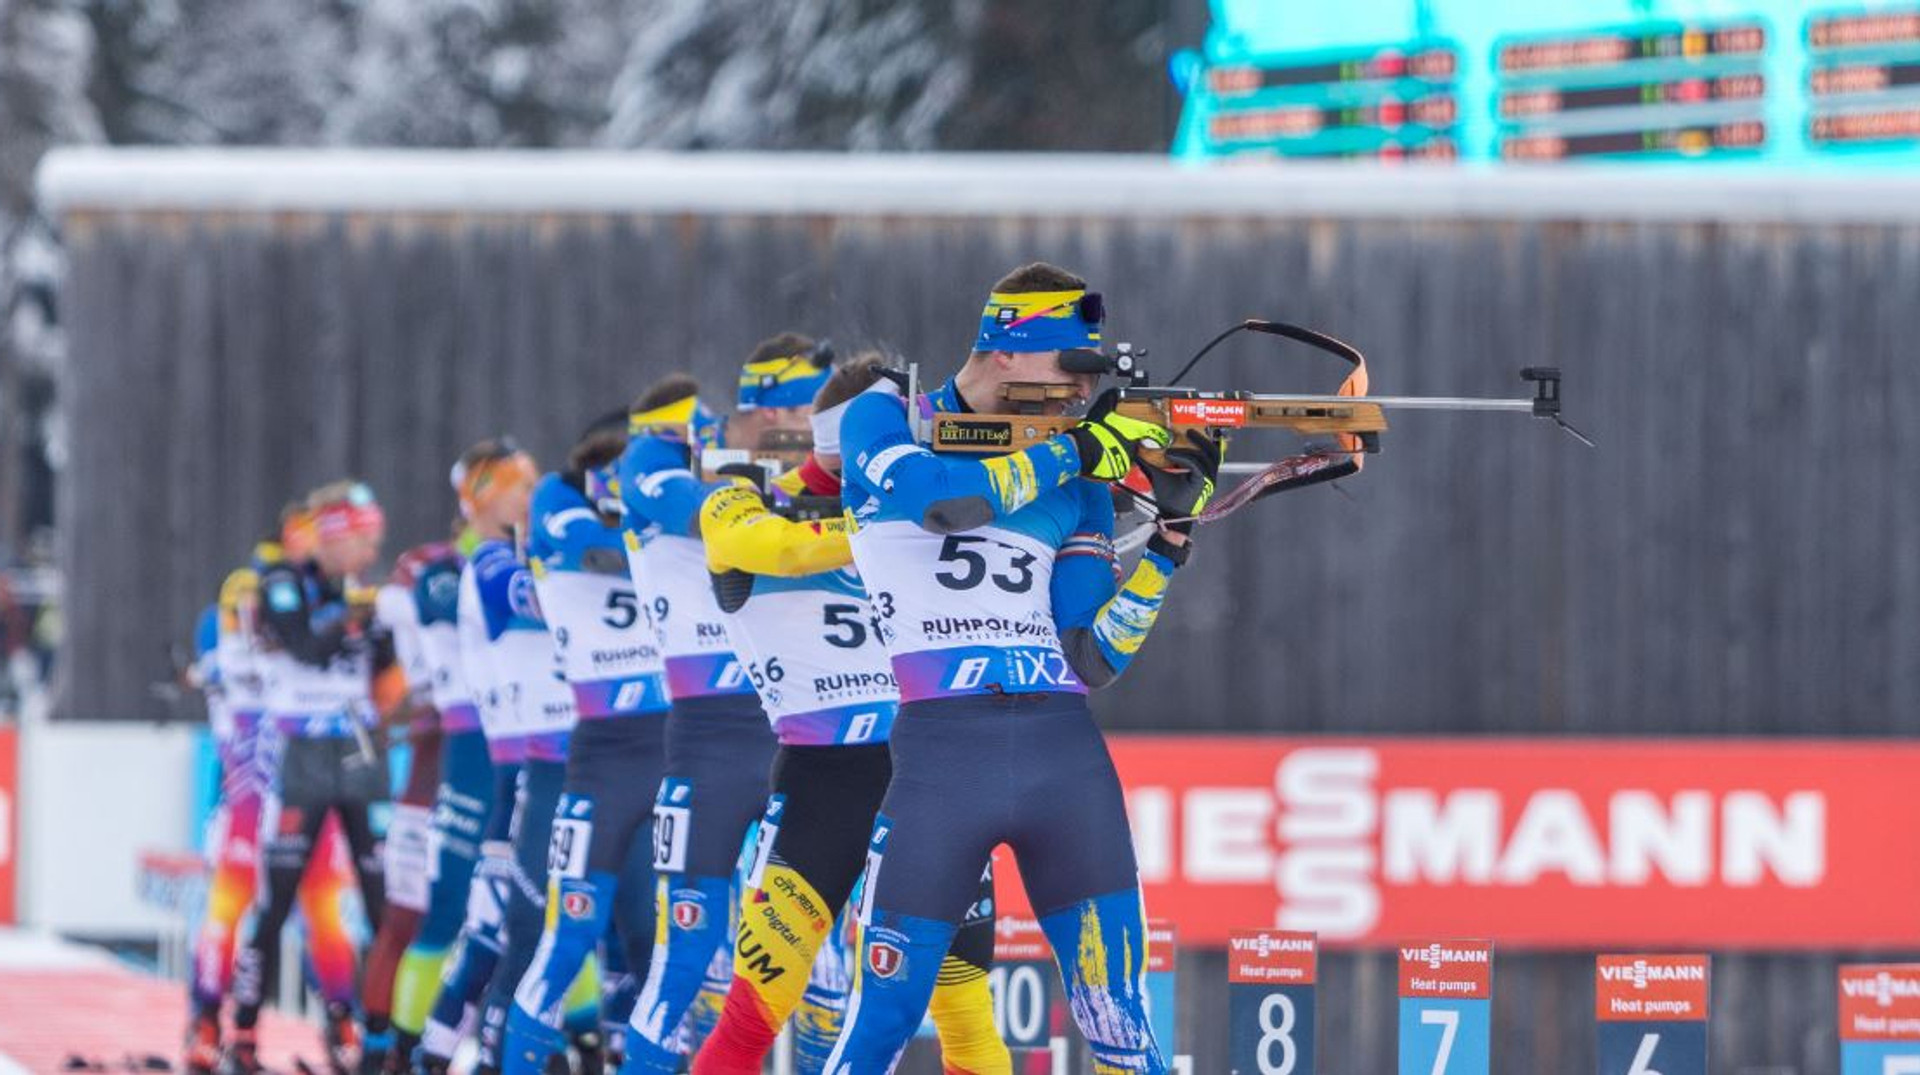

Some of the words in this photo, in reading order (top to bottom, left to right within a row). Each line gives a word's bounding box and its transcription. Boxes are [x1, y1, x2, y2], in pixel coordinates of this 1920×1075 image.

[1174, 402, 1243, 418] VIESSMANN
[934, 535, 1038, 594] 53
[696, 623, 727, 637] RU
[1014, 650, 1077, 686] iX2
[1130, 747, 1826, 938] IESSMANN
[1231, 934, 1314, 957] VIESSMANN
[1401, 944, 1488, 969] VIESSMANN
[1240, 964, 1264, 977] Heat
[1266, 968, 1303, 979] pumps
[1600, 960, 1704, 989] VIESSMANN
[1411, 978, 1437, 990] Heat
[1439, 982, 1477, 993] pumps
[991, 965, 1044, 1042] 10
[1611, 998, 1643, 1013] Heat
[1645, 1001, 1691, 1015] pumps
[1257, 993, 1297, 1075] 8
[1421, 1009, 1460, 1075] 7
